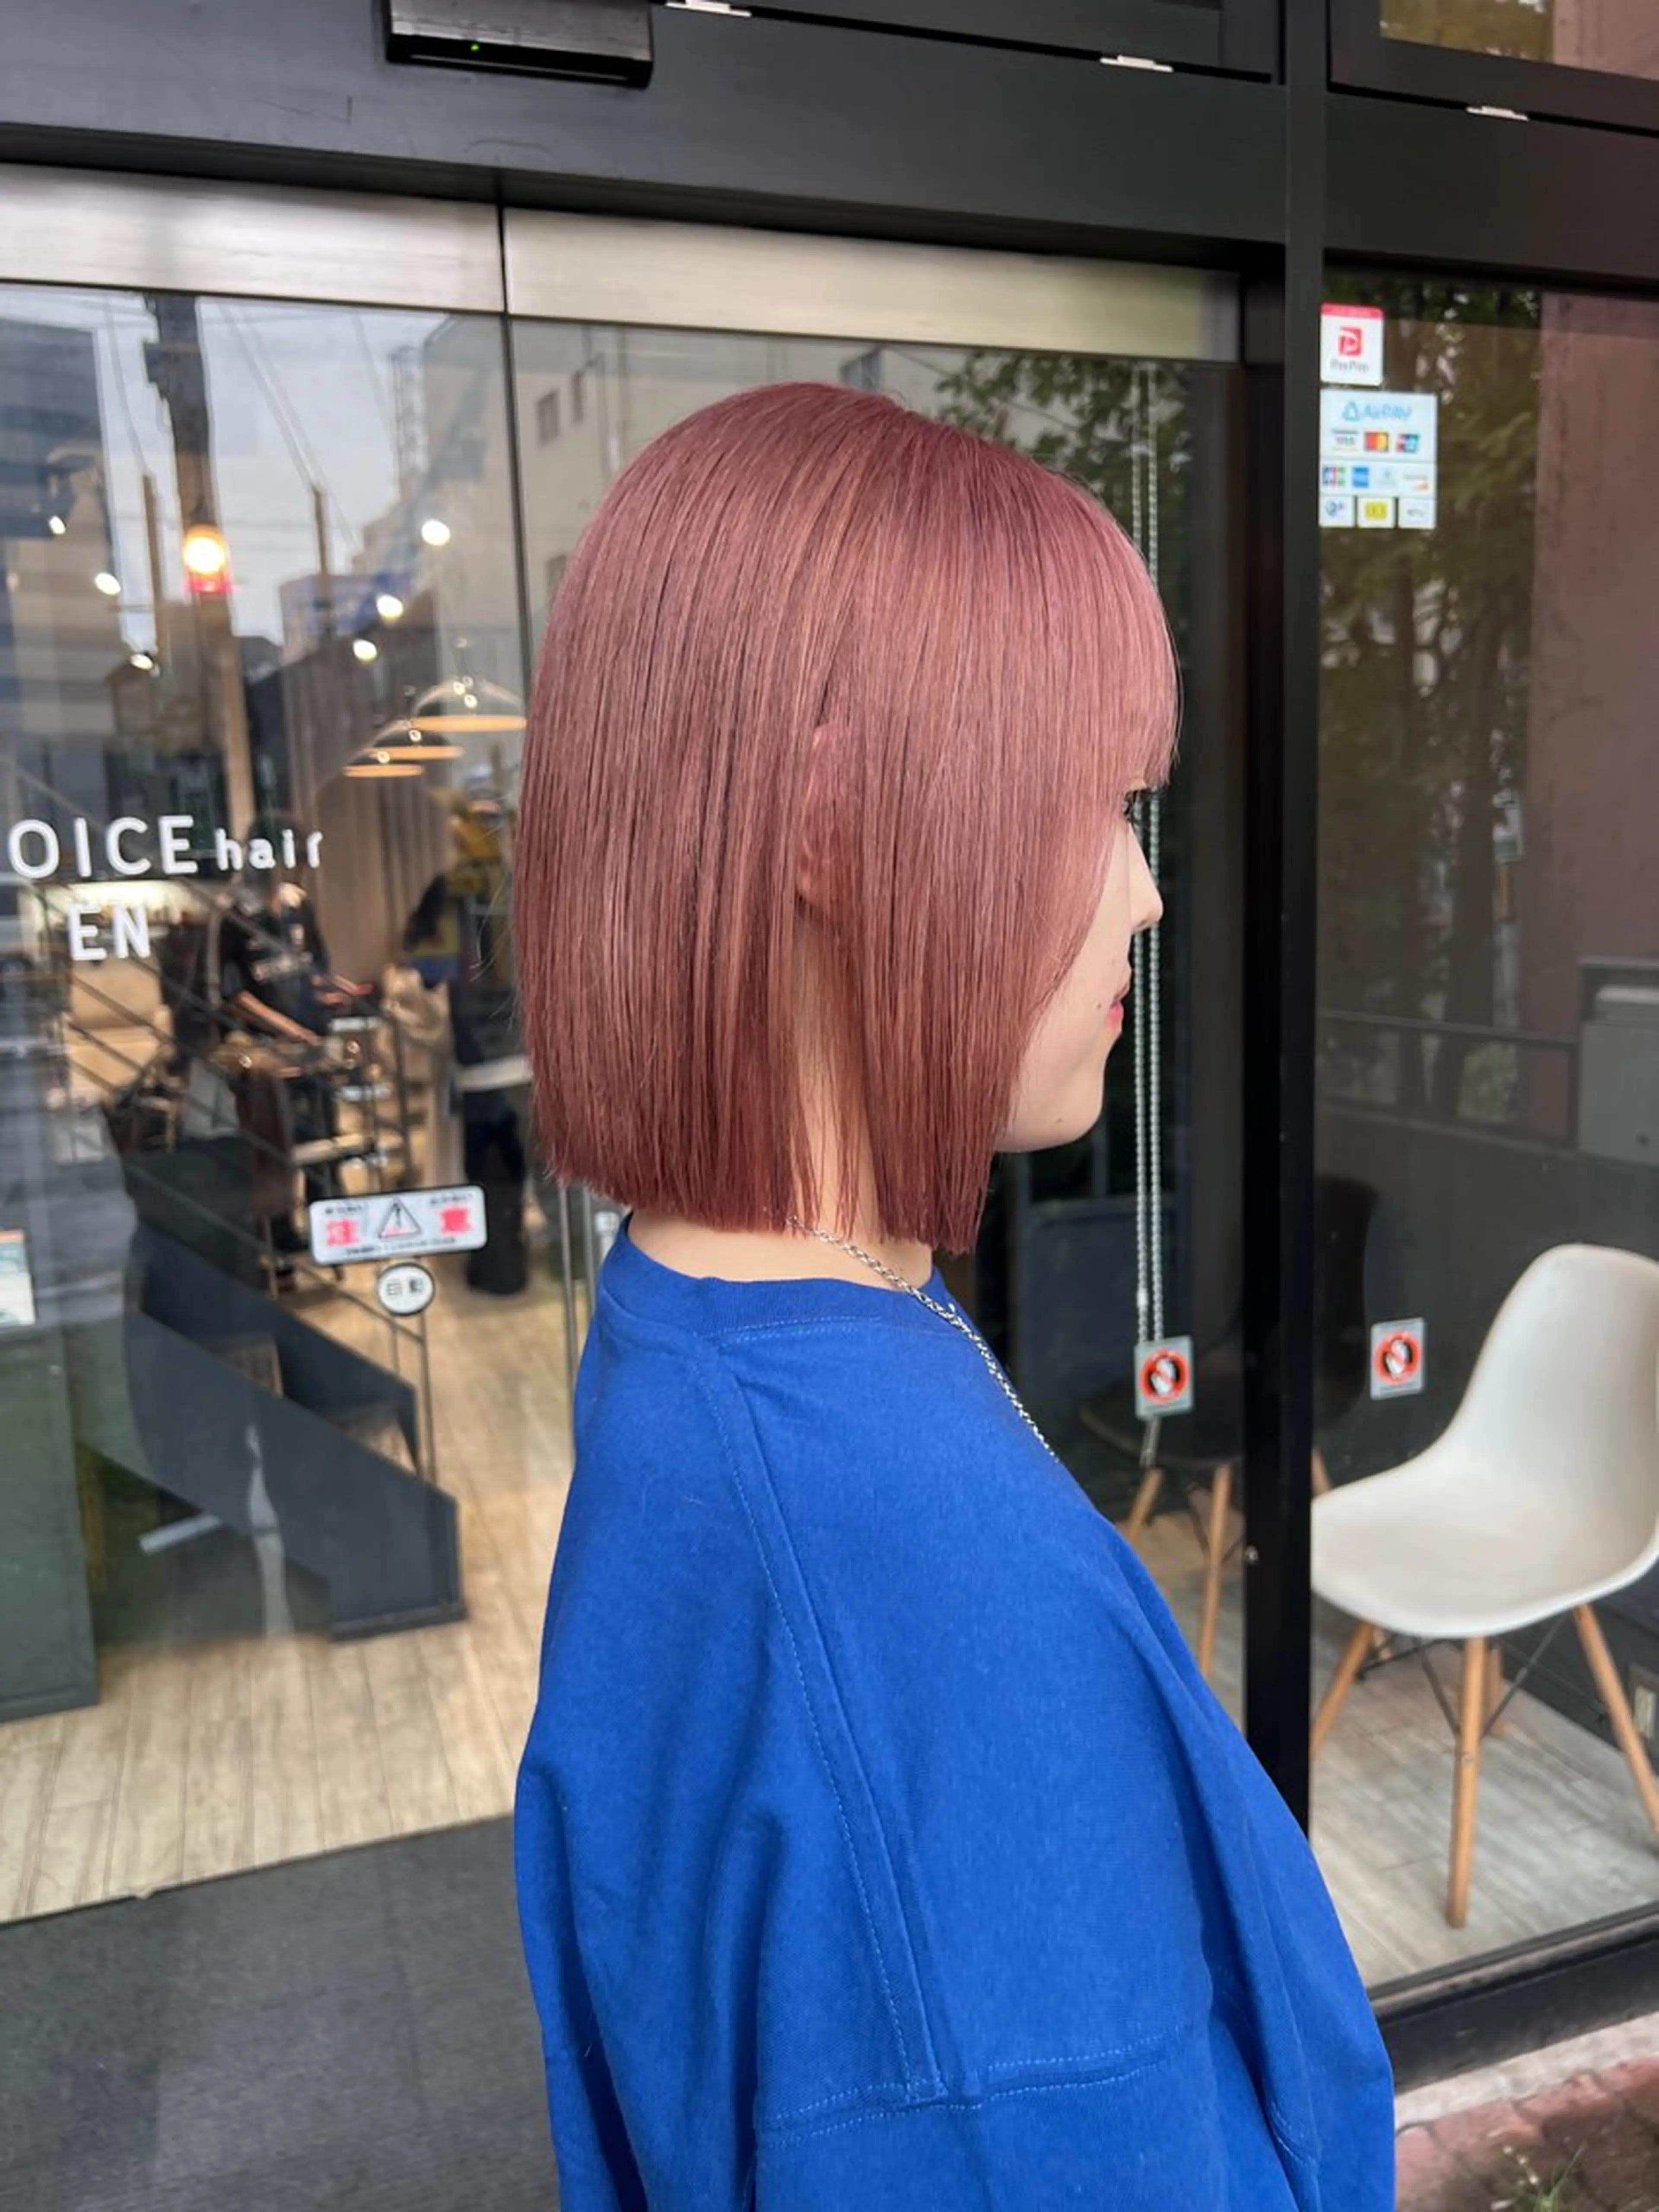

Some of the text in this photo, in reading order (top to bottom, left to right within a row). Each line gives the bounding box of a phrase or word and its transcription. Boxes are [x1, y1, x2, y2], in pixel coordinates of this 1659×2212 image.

[9, 815, 323, 879] OICE hair
[67, 903, 151, 961] EN
